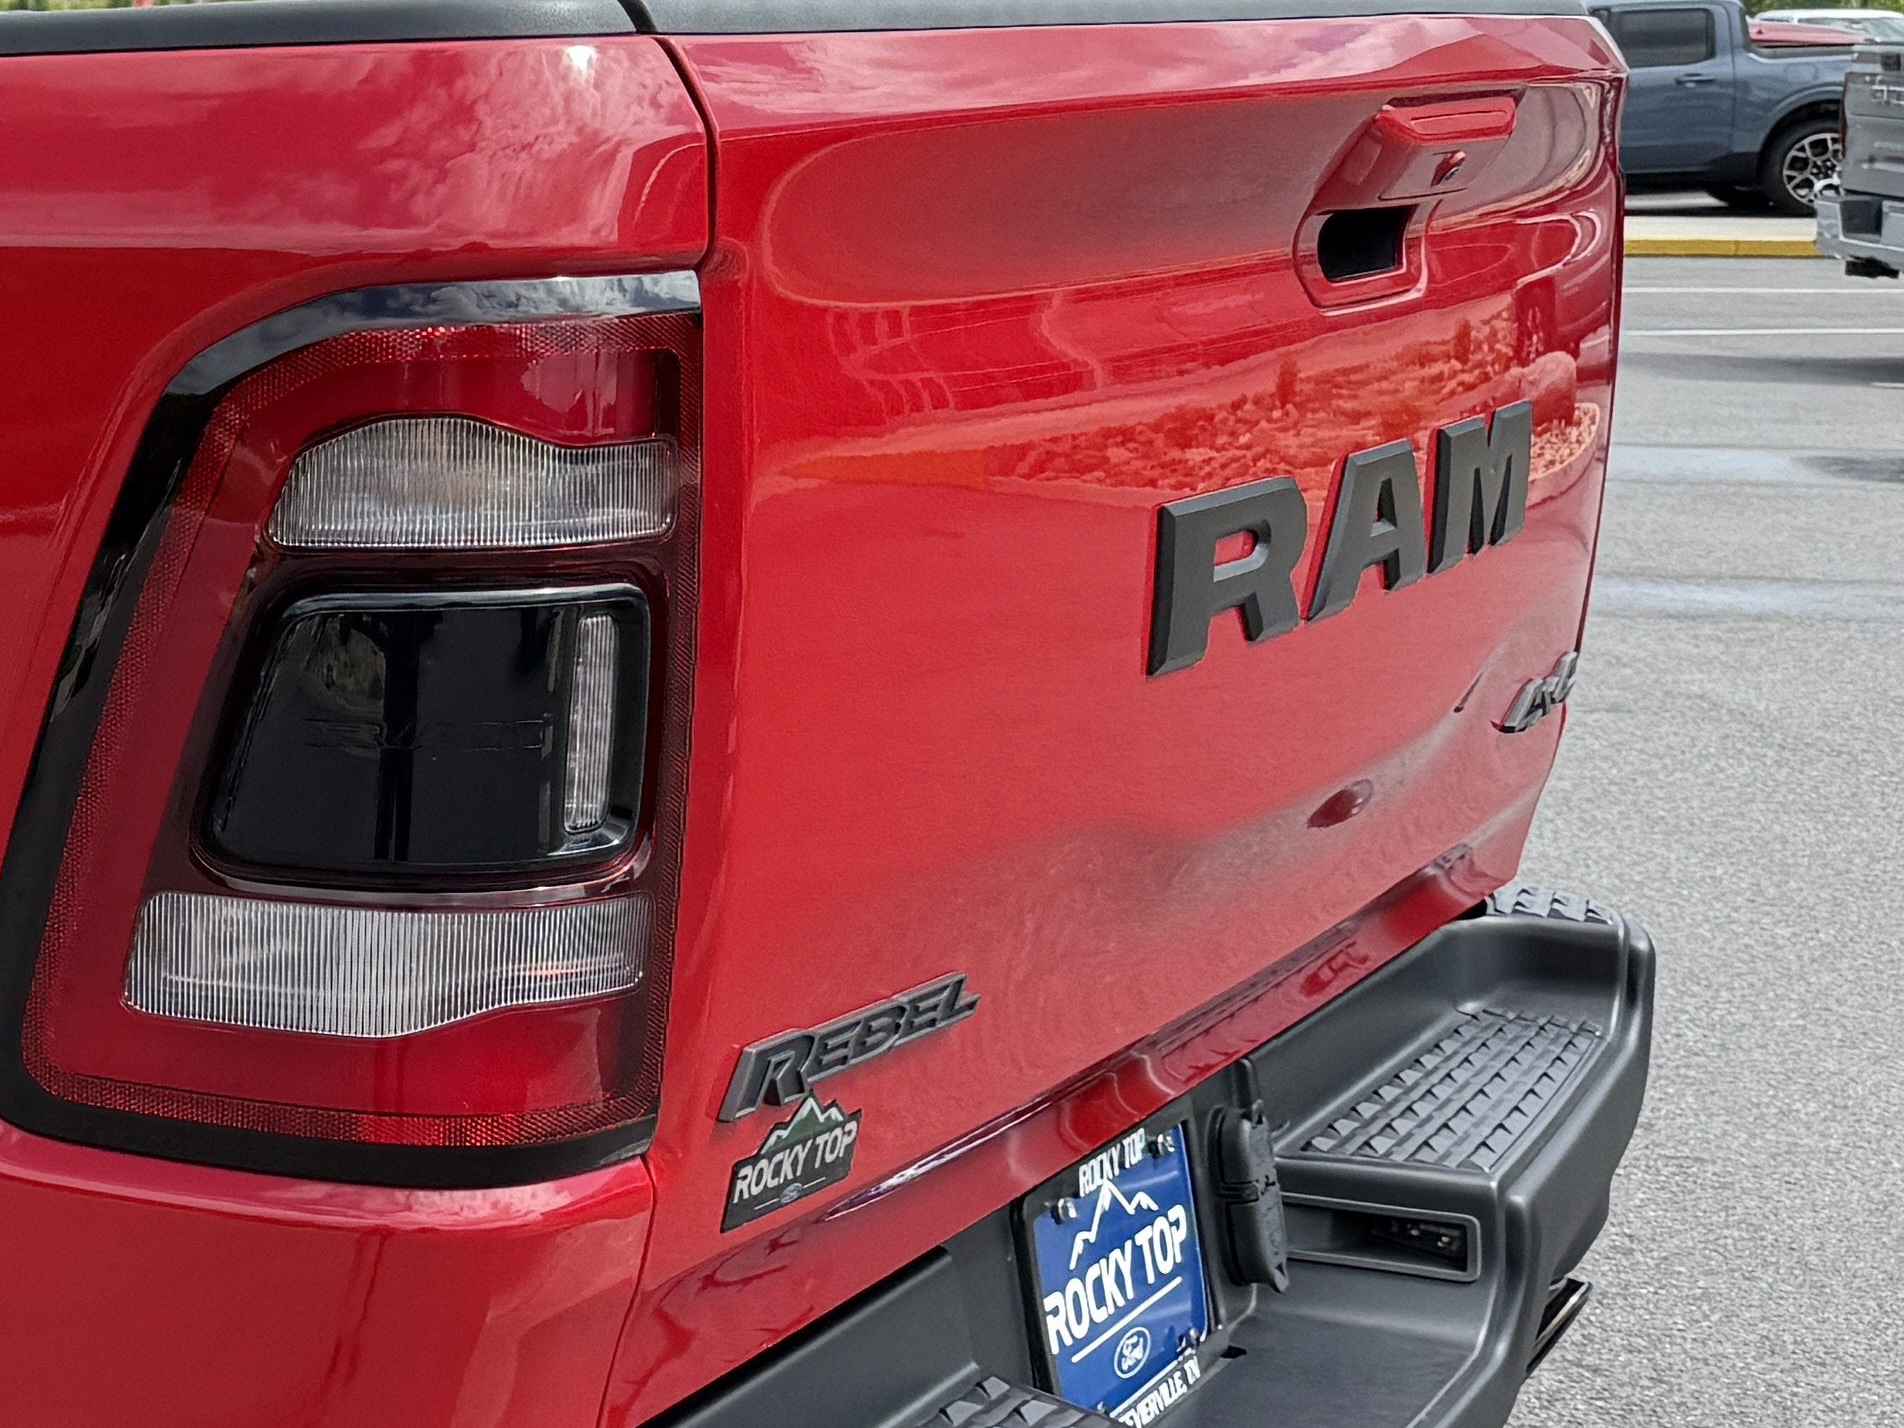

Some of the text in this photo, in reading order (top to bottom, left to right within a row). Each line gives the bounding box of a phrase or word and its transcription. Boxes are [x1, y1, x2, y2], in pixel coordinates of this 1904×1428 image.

[1146, 399, 1533, 679] RAM
[717, 971, 982, 1122] REBEL
[733, 1139, 813, 1204] ROCKY
[815, 1121, 859, 1169] TOP
[1078, 1127, 1145, 1197] ROCKY TOP
[1043, 1204, 1187, 1356] ROCKY TOP
